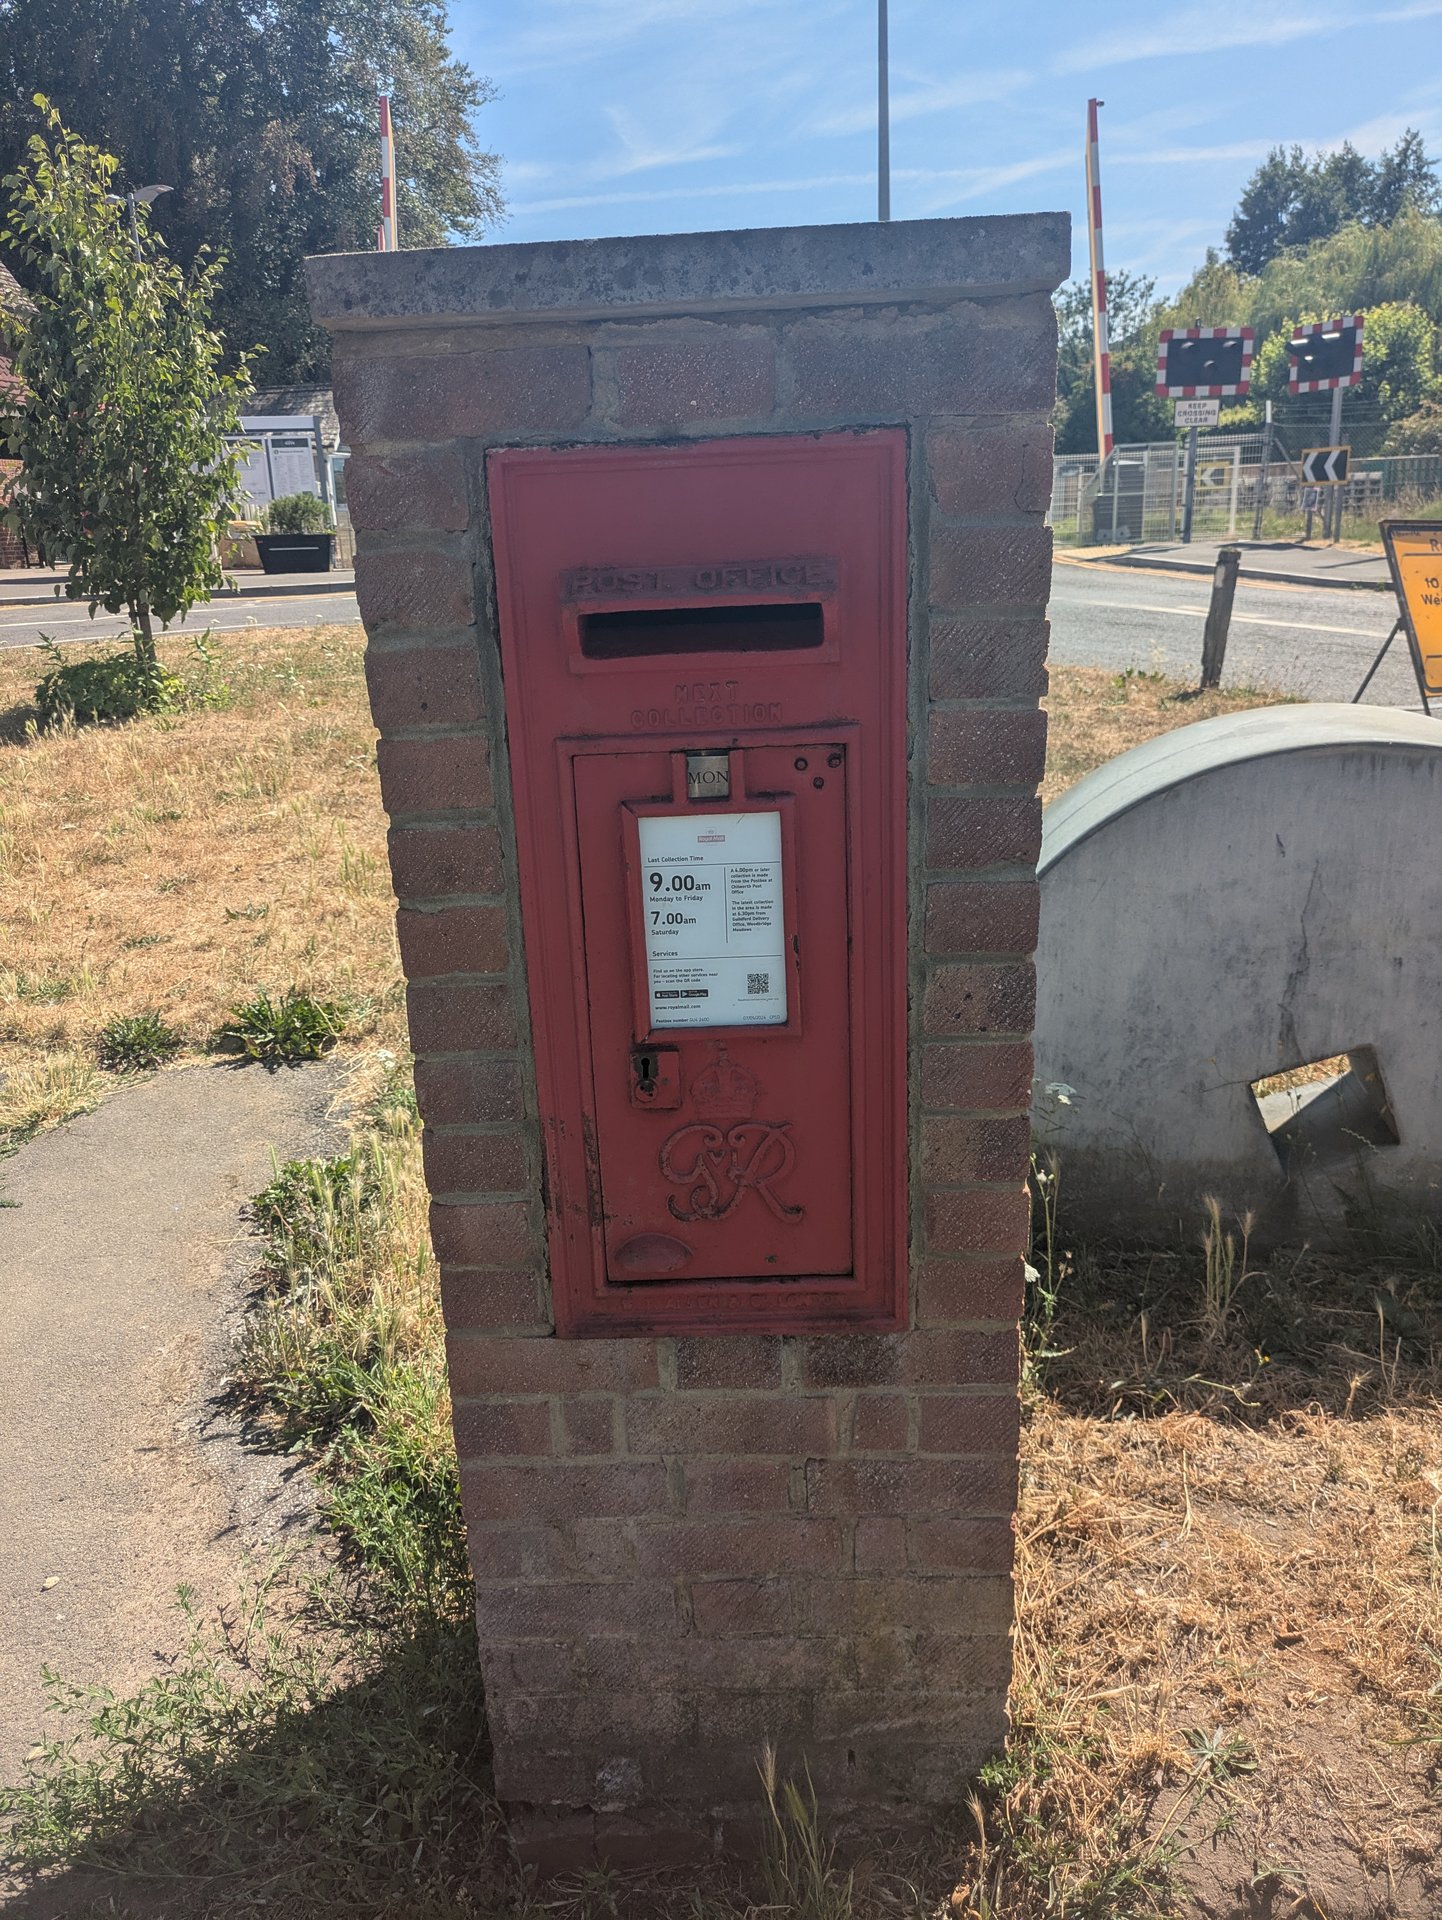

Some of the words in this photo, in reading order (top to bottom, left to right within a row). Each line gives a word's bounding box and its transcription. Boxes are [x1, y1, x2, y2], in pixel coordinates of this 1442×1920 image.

[1177, 409, 1216, 417] CROSSING
[570, 570, 666, 593] POST
[694, 565, 825, 591] OFFICE
[1421, 594, 1442, 605] We
[674, 680, 739, 703] NEXT
[630, 703, 783, 729] COLLECTION
[688, 771, 728, 784] MON
[650, 872, 711, 892] 9.00am
[651, 911, 697, 925] 7.00am
